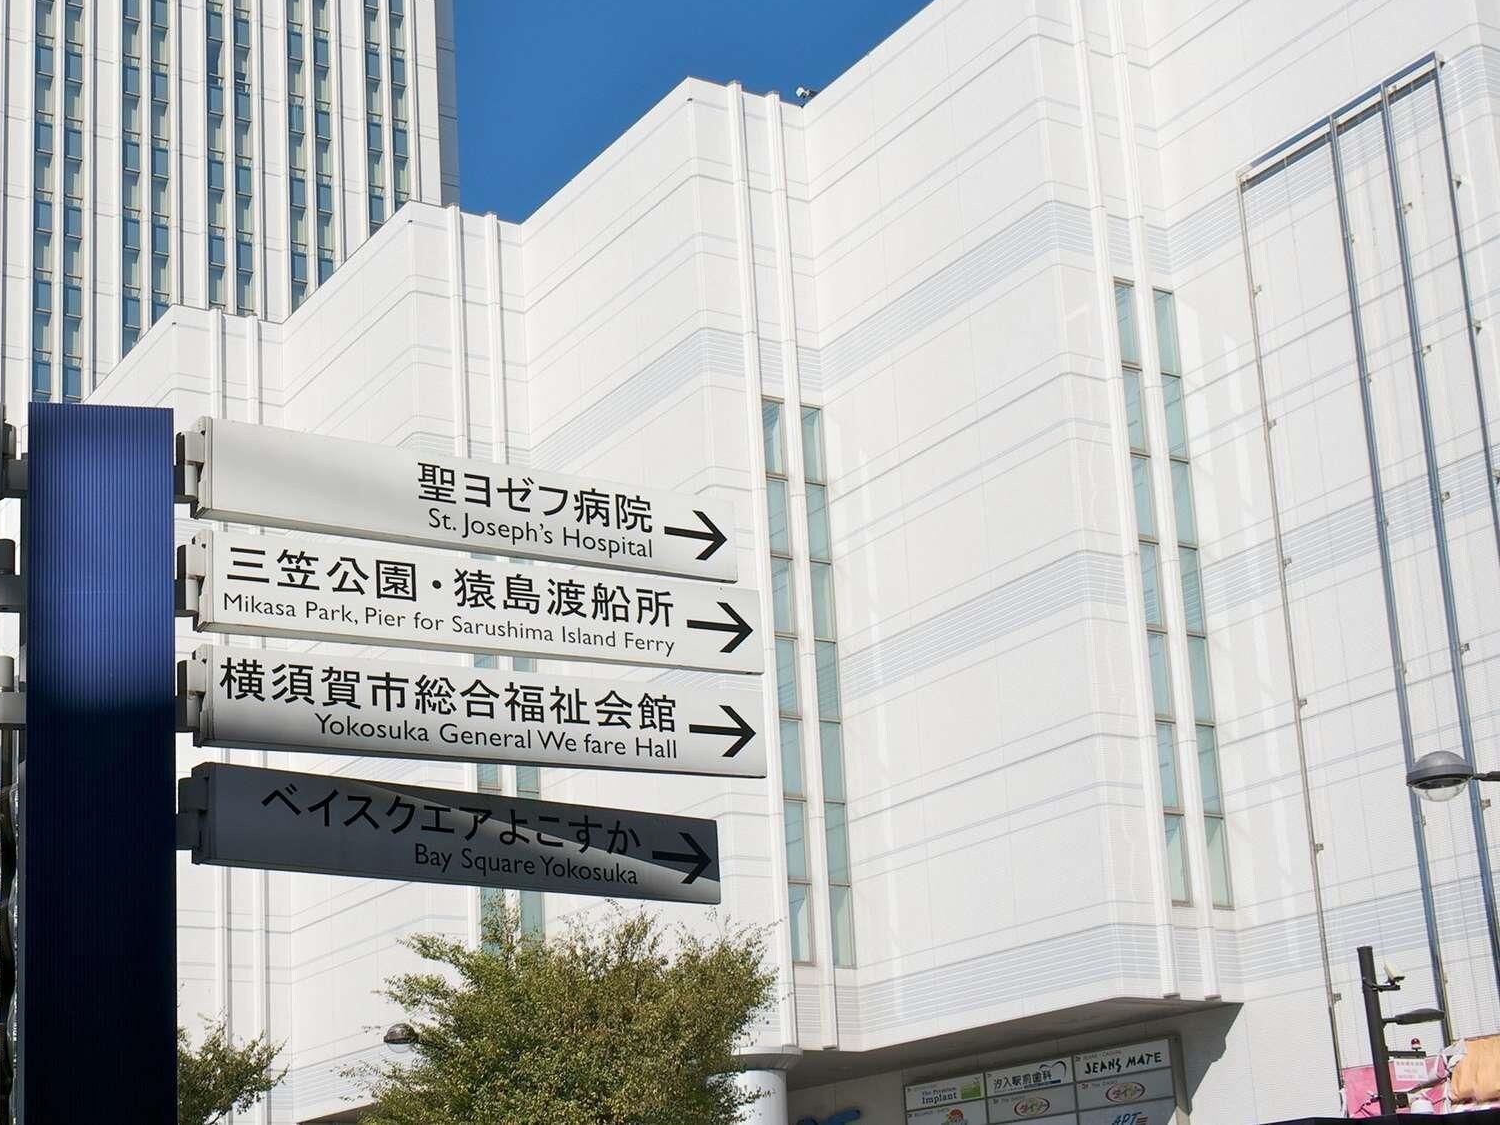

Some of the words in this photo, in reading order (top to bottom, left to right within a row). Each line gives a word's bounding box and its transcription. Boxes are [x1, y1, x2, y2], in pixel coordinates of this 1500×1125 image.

[418, 462, 653, 534] 聖ヨゼフ病院
[428, 507, 457, 532] St.
[461, 512, 554, 546] Joseph's
[563, 526, 653, 559] Hospital
[226, 547, 674, 628] 三笠公園・猿島渡船所
[223, 592, 296, 618] Mikasa
[305, 600, 359, 626] Park,
[365, 606, 407, 627] Pier
[414, 611, 445, 631] for
[452, 615, 554, 643] Sarushima
[562, 625, 616, 648] Island
[625, 631, 675, 658] Ferry
[219, 657, 677, 733] 横須賀市総合福祉会館
[314, 712, 430, 743] Yokosuka
[439, 723, 532, 749] General
[635, 737, 677, 759] Hall
[260, 783, 642, 855] ベイスクエアよこすか
[414, 842, 452, 874] Bay
[461, 848, 536, 876] Square
[539, 855, 639, 885] Yokosuka
[1084, 1057, 1122, 1074] JEANS
[1126, 1052, 1162, 1068] MATE
[921, 1092, 957, 1105] Implant
